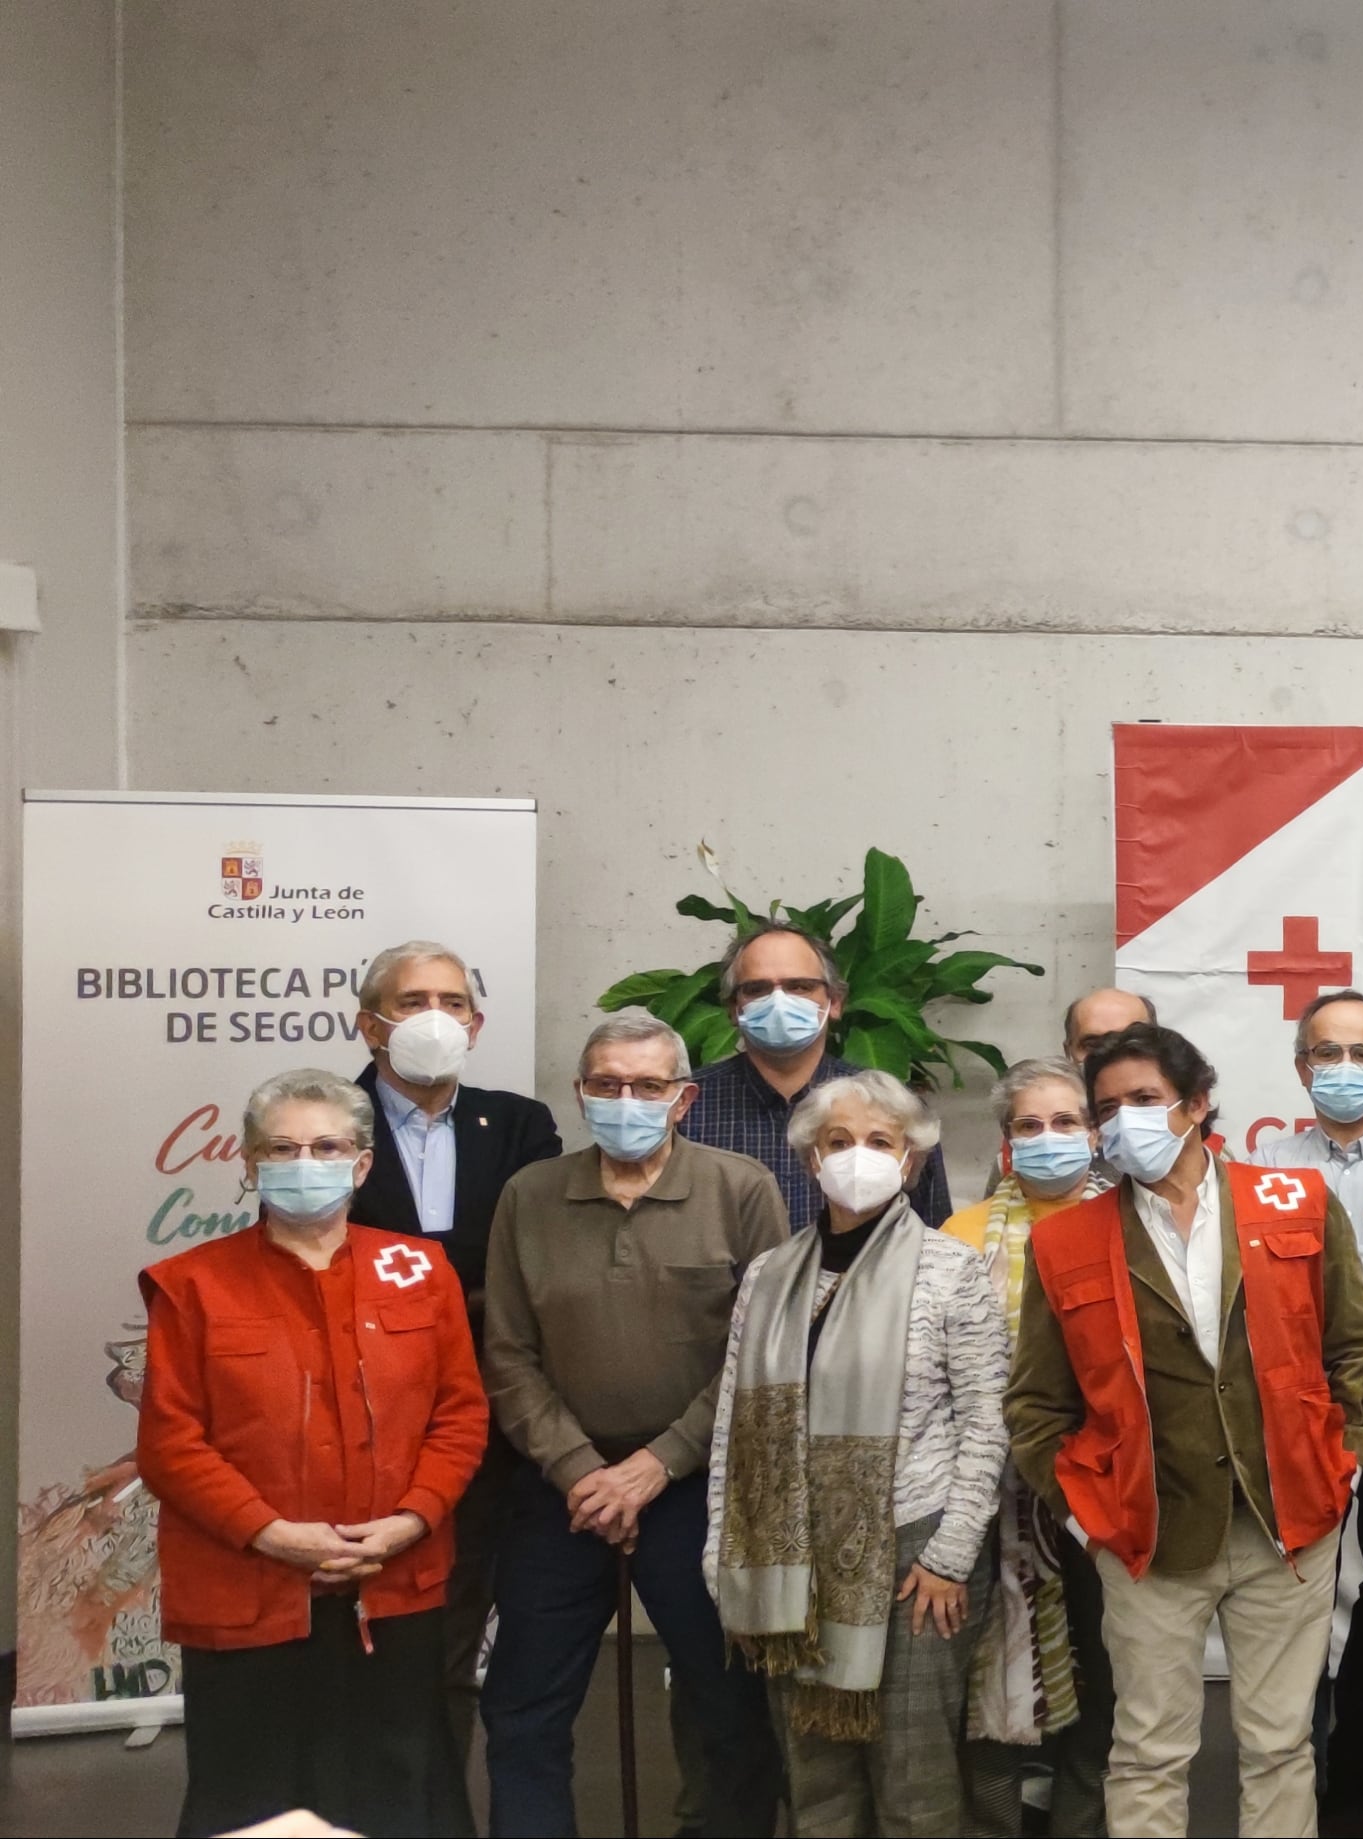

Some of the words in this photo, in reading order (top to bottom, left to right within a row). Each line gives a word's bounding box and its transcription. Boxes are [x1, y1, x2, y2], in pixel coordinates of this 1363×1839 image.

[269, 884, 331, 900] Junta
[338, 885, 365, 900] de
[207, 903, 286, 919] Castilla
[292, 907, 305, 924] y
[311, 904, 365, 920] León
[76, 967, 311, 1000] BIBLIOTECA
[166, 1012, 218, 1043] DE
[228, 1010, 360, 1044] SEGOV
[154, 1103, 242, 1175] Cu
